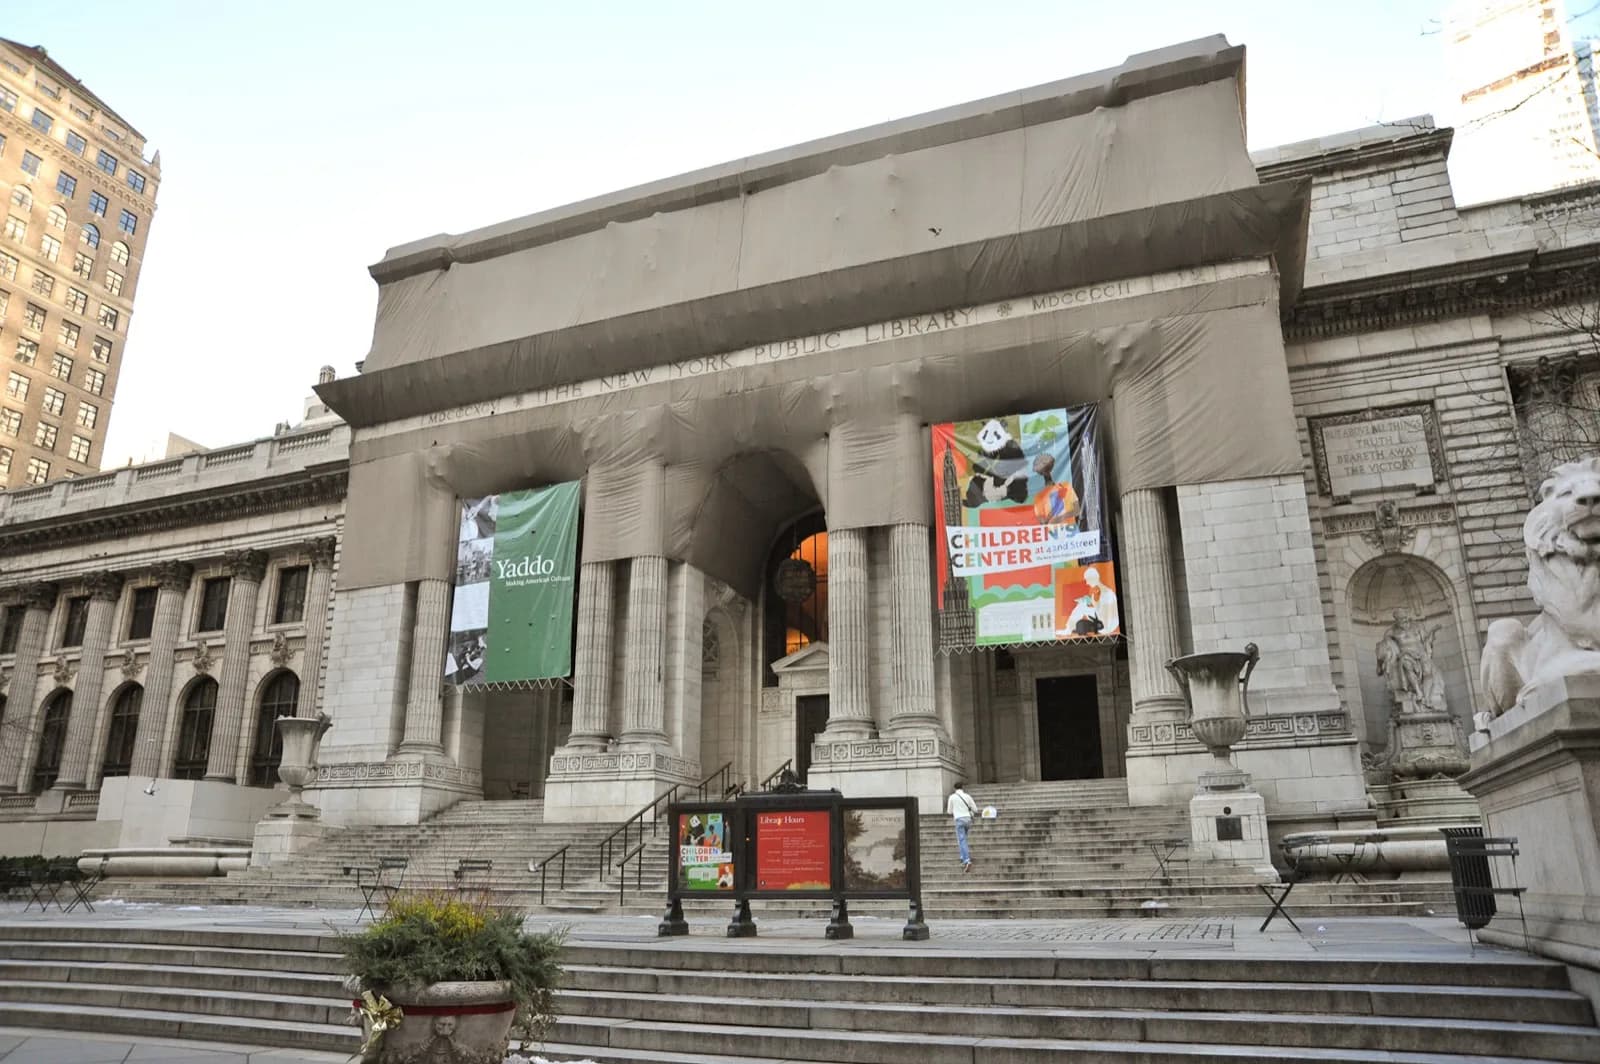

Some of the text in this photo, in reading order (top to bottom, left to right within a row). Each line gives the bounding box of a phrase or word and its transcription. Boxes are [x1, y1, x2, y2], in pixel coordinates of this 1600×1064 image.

[600, 367, 653, 391] NEW
[672, 354, 732, 377] YORK
[754, 331, 841, 360] PUBLIC
[864, 308, 977, 342] LIBRARY
[1032, 281, 1130, 311] MDCCCCII
[1358, 436, 1393, 449] TRUTH
[1337, 445, 1417, 464] BEARETH AWAY
[1344, 457, 1416, 476] THE VICTORY
[951, 523, 1080, 549] CHILDREN'S
[951, 548, 1033, 568] CENTER
[1035, 545, 1044, 554] at
[1070, 538, 1097, 549] Street
[496, 554, 555, 579] Yaddo
[526, 577, 550, 585] American
[760, 815, 805, 826] Library Hours
[681, 846, 723, 856] CHILDREN
